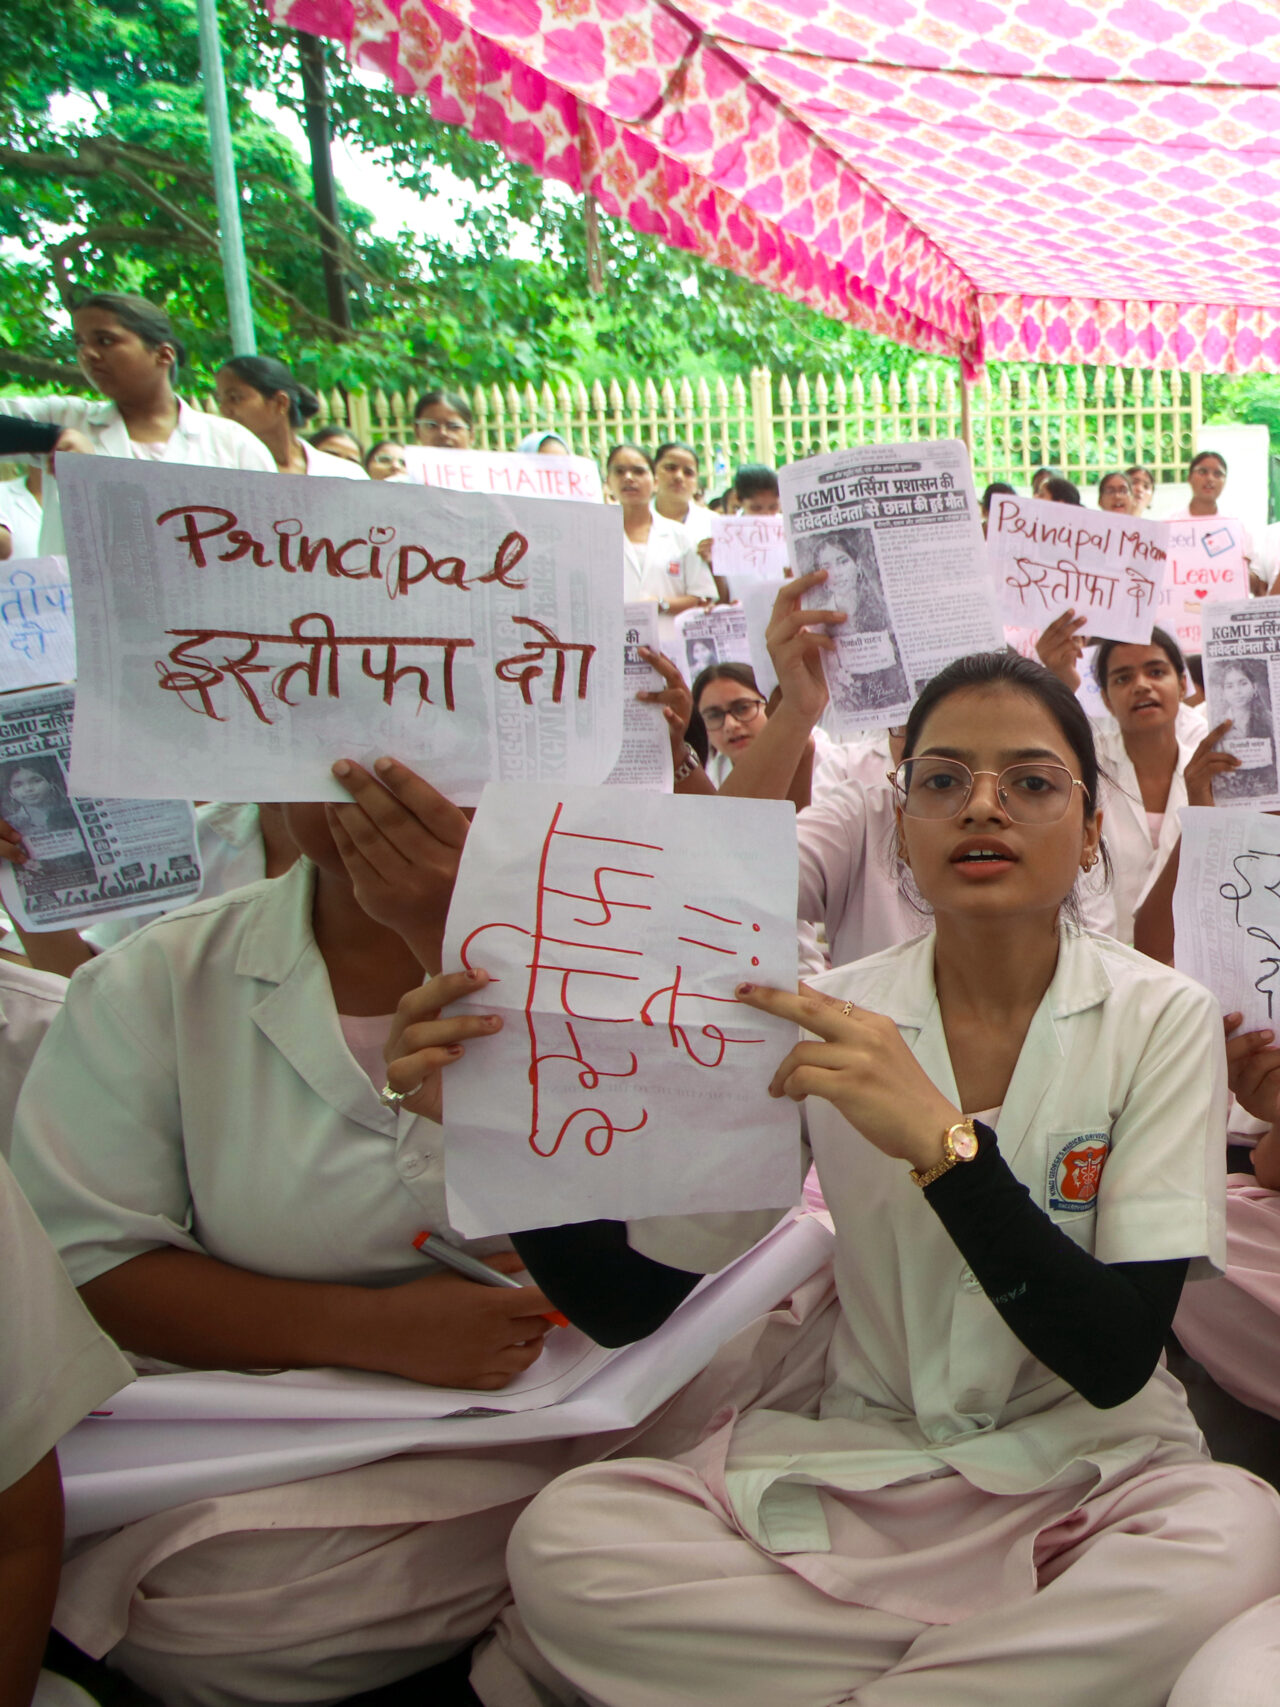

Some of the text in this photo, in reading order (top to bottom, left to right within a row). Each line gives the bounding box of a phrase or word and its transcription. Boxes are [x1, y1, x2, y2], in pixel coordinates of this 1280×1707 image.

[422, 463, 596, 497] LIFE MATTERS
[795, 484, 845, 511] KGMU
[849, 474, 889, 498] नर्सिंग
[893, 477, 938, 495] प्रशासन
[939, 472, 954, 490] की
[793, 504, 863, 532] संवेदनहीनता
[865, 499, 880, 517] से
[884, 497, 912, 515] छात्रा
[915, 496, 930, 512] की
[945, 492, 965, 510] मौत
[1168, 528, 1197, 549] eed
[157, 505, 530, 600] Principal
[1173, 560, 1234, 586] Leave
[626, 629, 640, 644] की
[1212, 625, 1252, 639] KGMU
[1265, 638, 1277, 652] से
[155, 611, 475, 725] इस्तीफा
[0, 719, 38, 739] GMU
